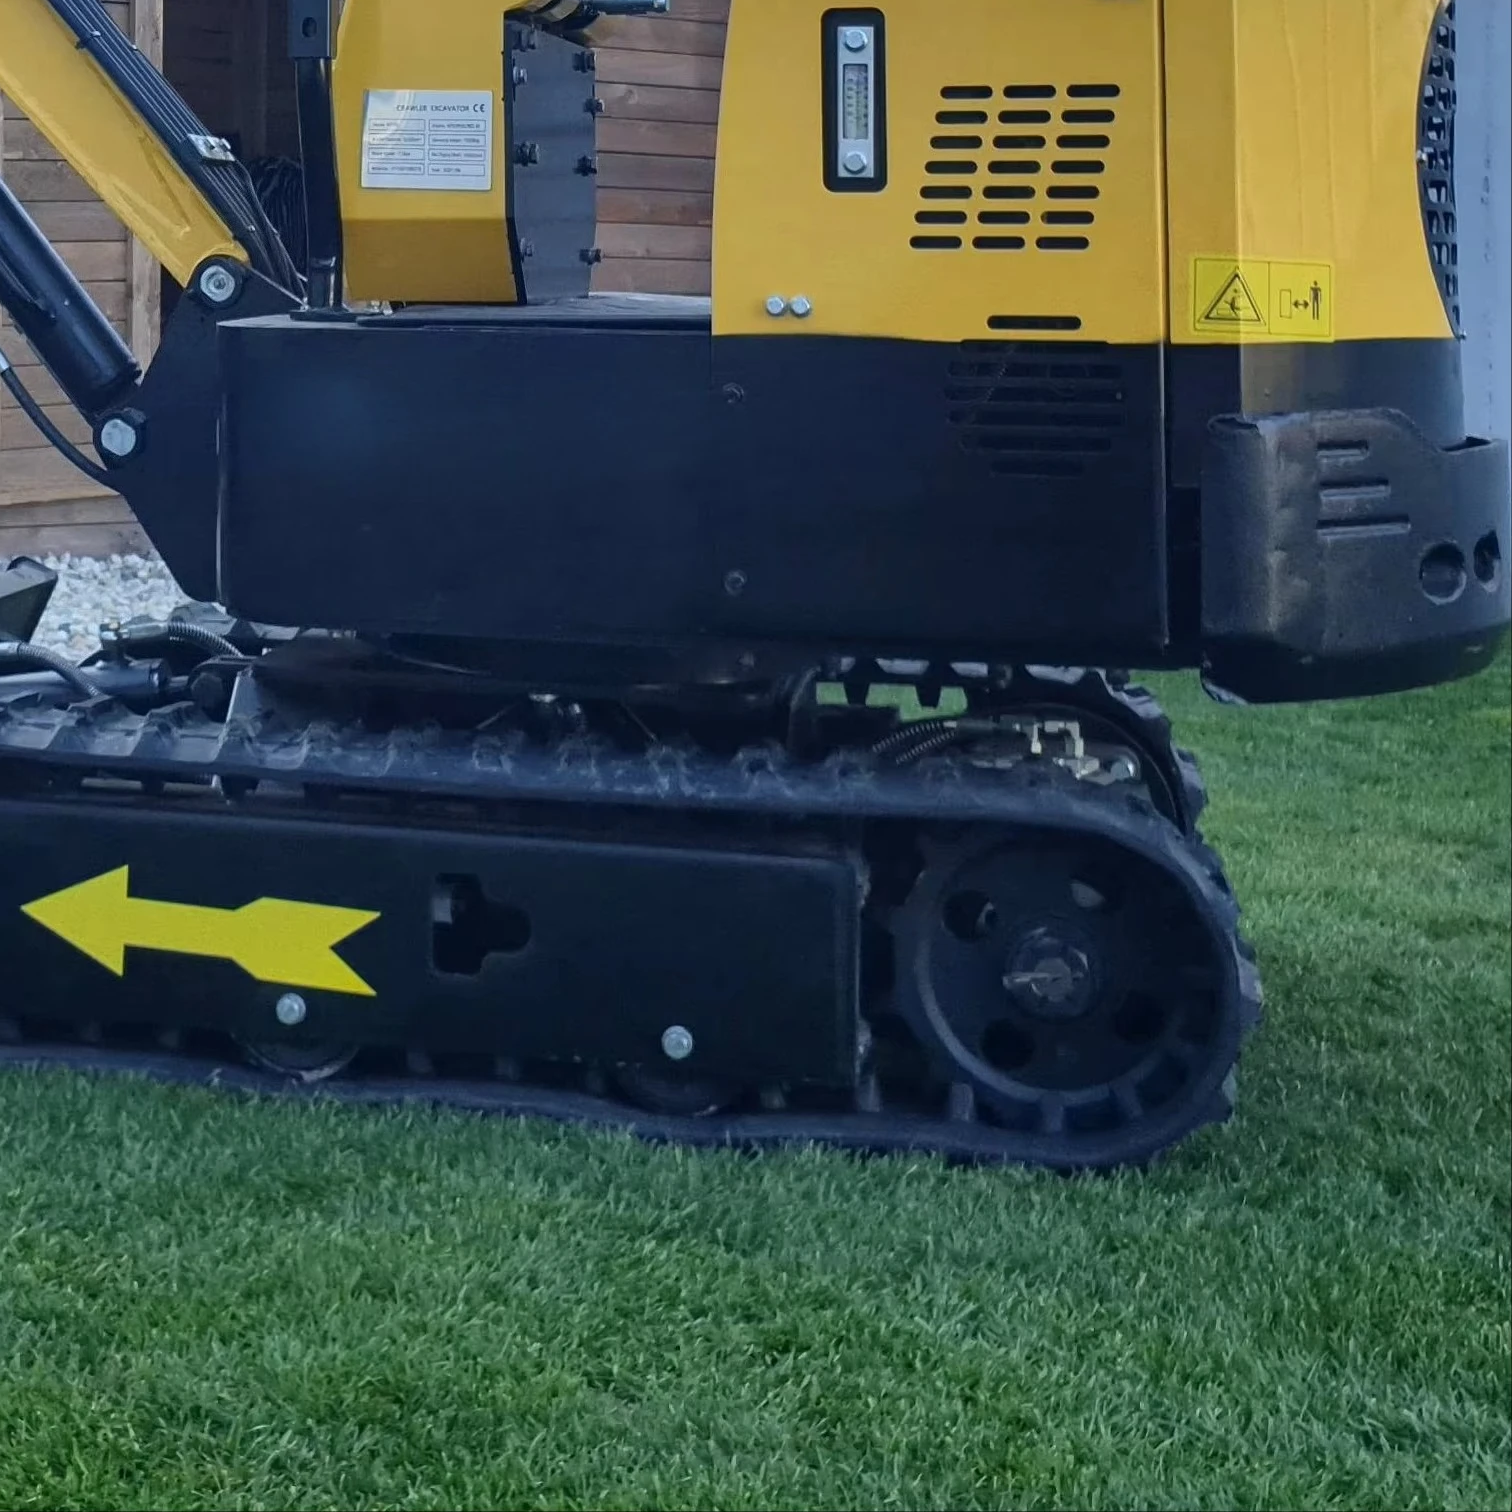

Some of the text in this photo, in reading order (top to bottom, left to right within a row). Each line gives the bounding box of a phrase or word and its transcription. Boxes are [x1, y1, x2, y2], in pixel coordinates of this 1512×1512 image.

[396, 103, 486, 113] CRAWLER EXCAVATOR CE
